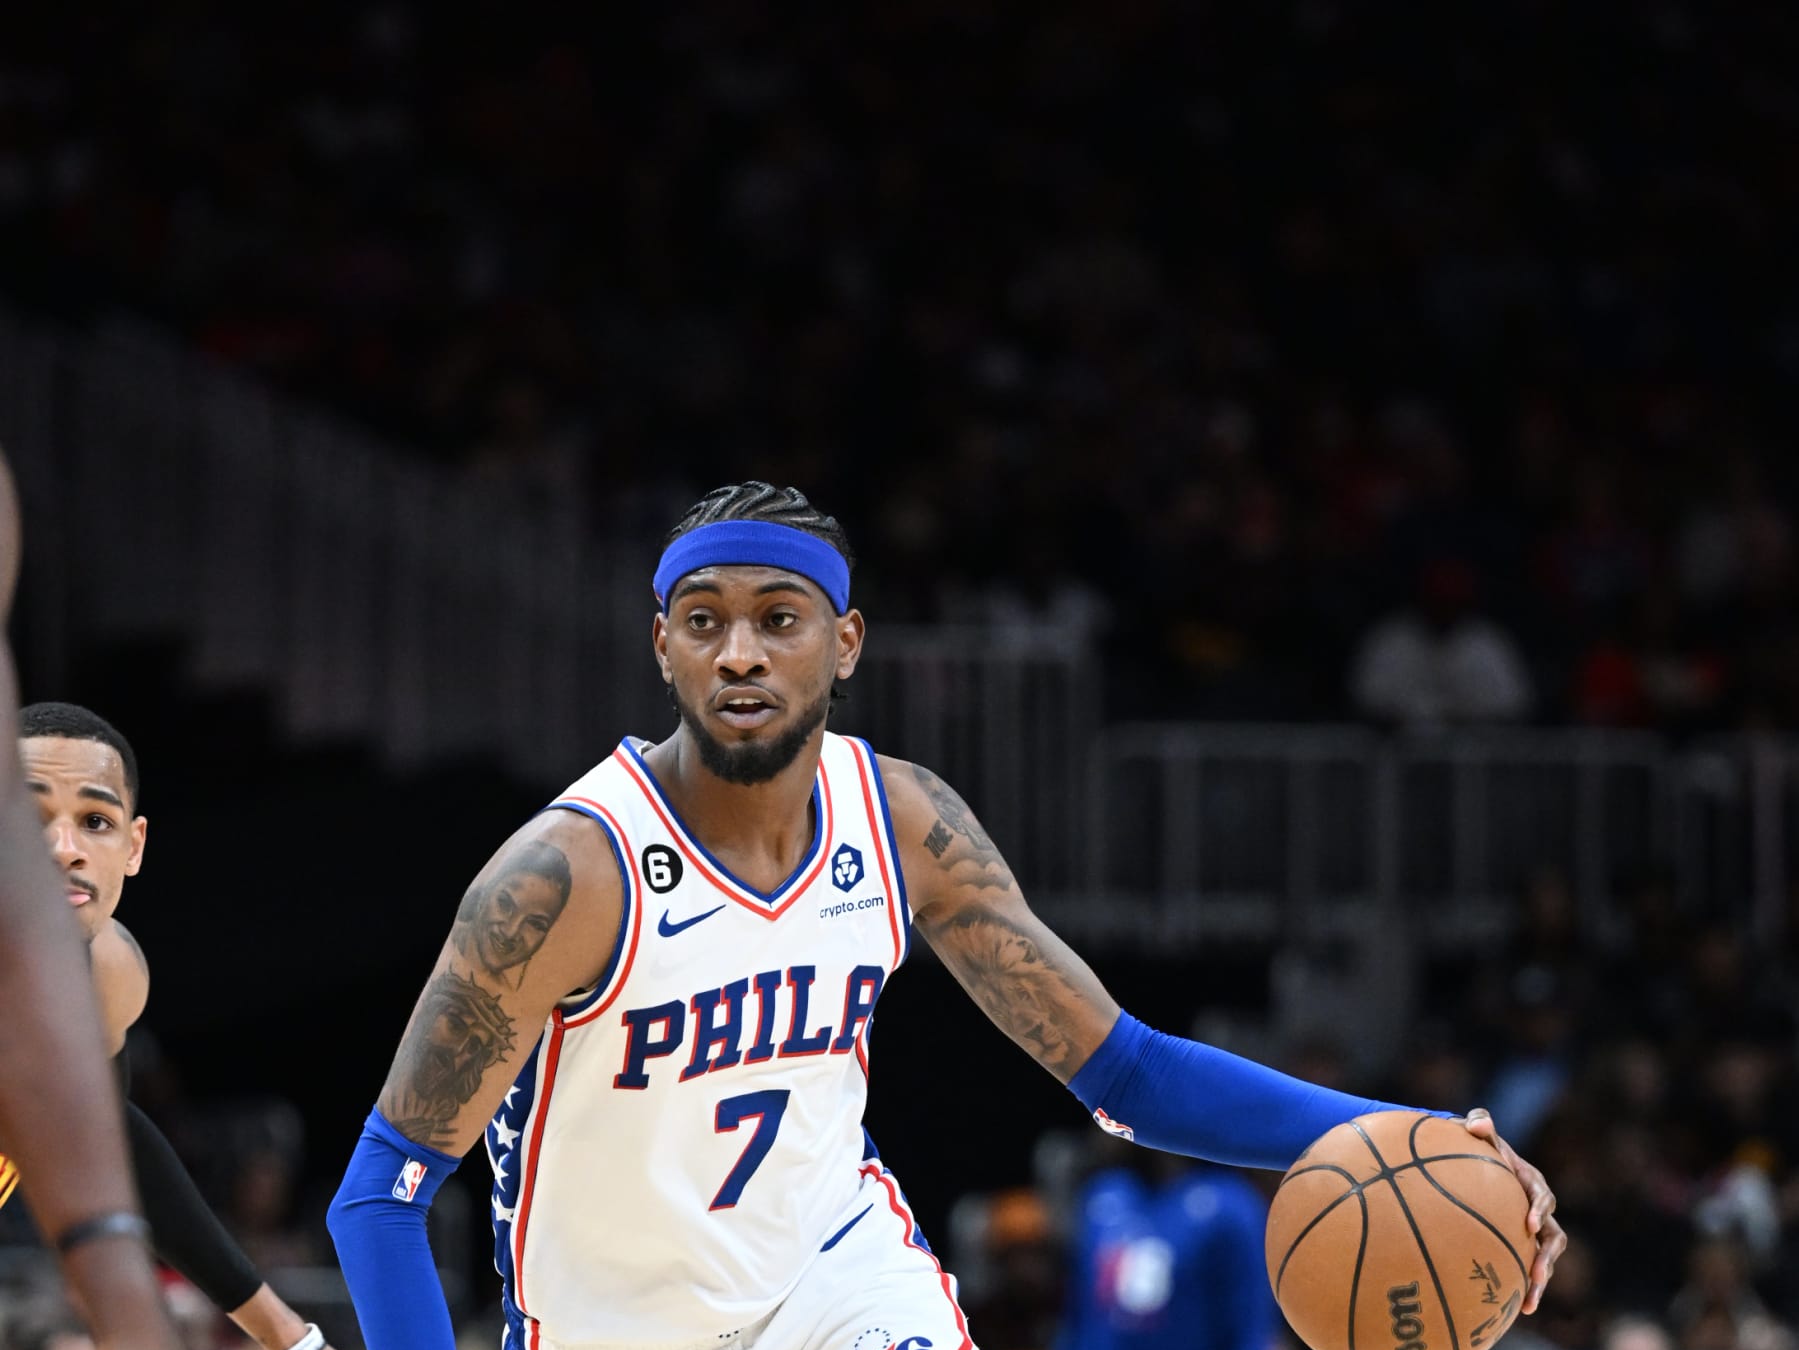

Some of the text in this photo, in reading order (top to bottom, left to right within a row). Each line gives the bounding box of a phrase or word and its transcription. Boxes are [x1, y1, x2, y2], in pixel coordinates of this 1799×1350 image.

[647, 851, 672, 888] 6
[819, 896, 884, 919] crypto.com
[613, 964, 885, 1090] PHILA
[708, 1089, 791, 1212] 7
